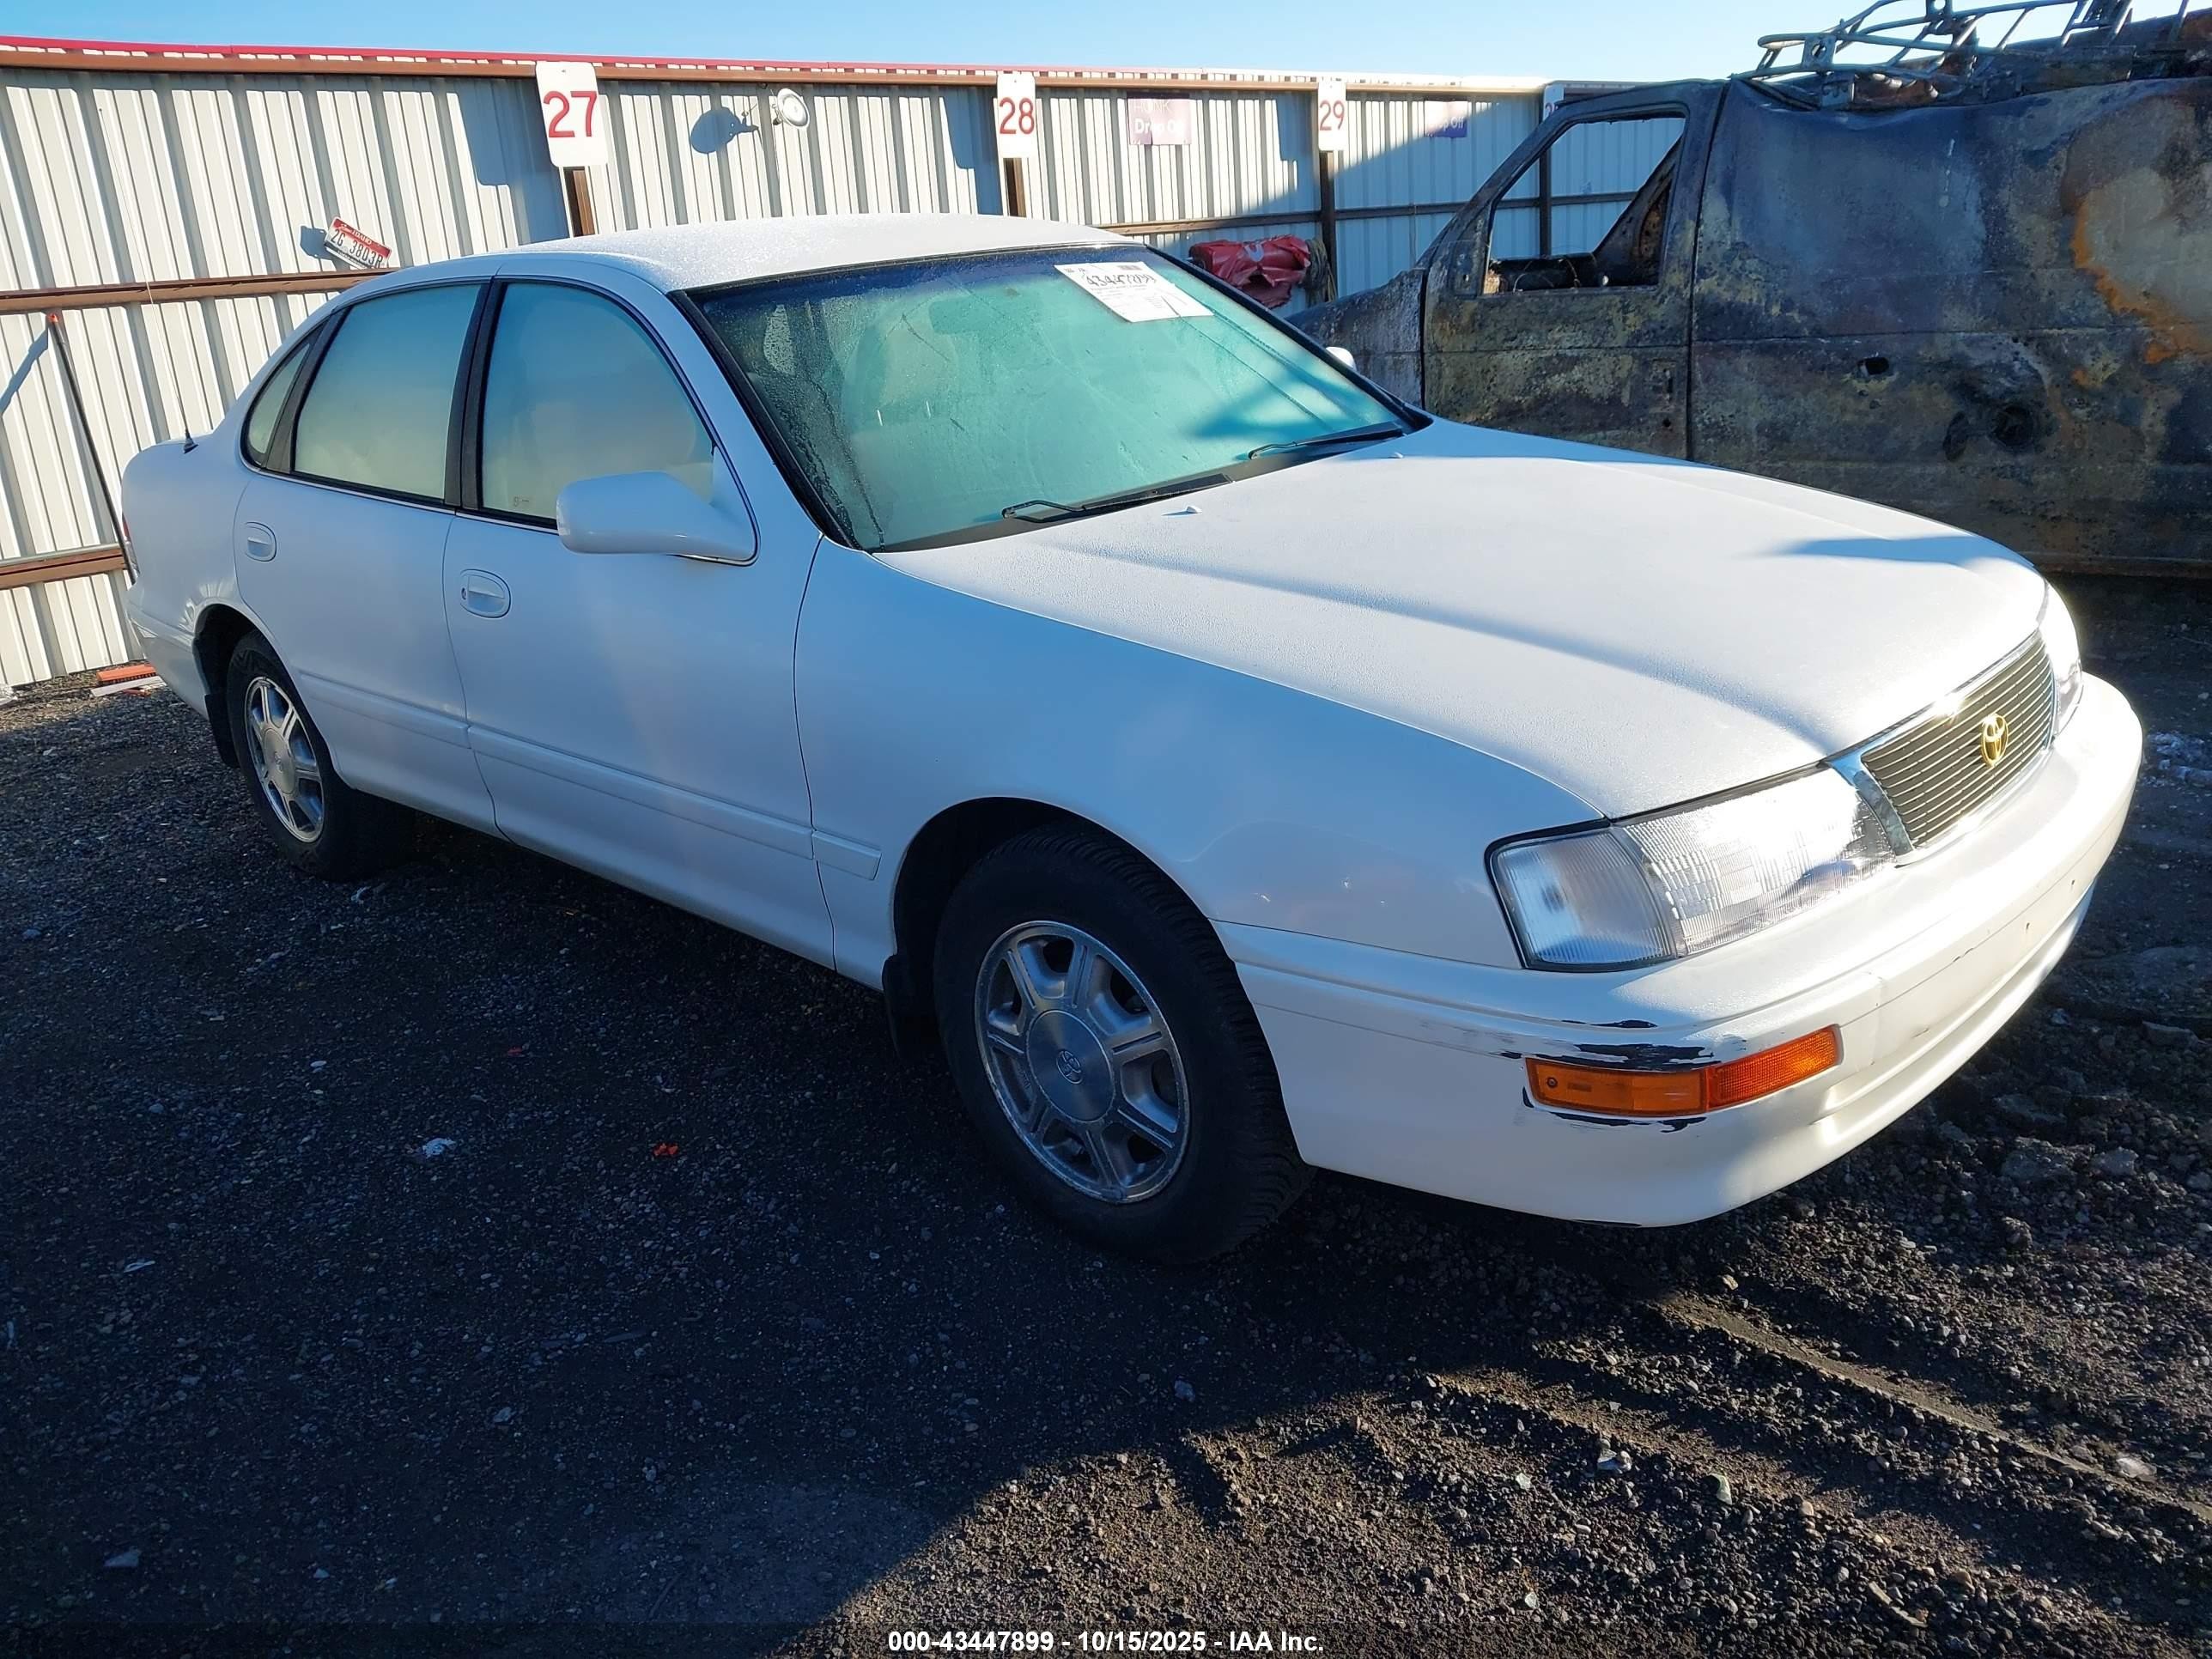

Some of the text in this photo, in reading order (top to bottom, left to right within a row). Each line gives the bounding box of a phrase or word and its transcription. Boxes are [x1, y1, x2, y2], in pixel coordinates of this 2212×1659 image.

[543, 91, 598, 137] 27
[999, 97, 1035, 134] 28
[1319, 100, 1346, 131] 29
[351, 229, 373, 245] IDAHO
